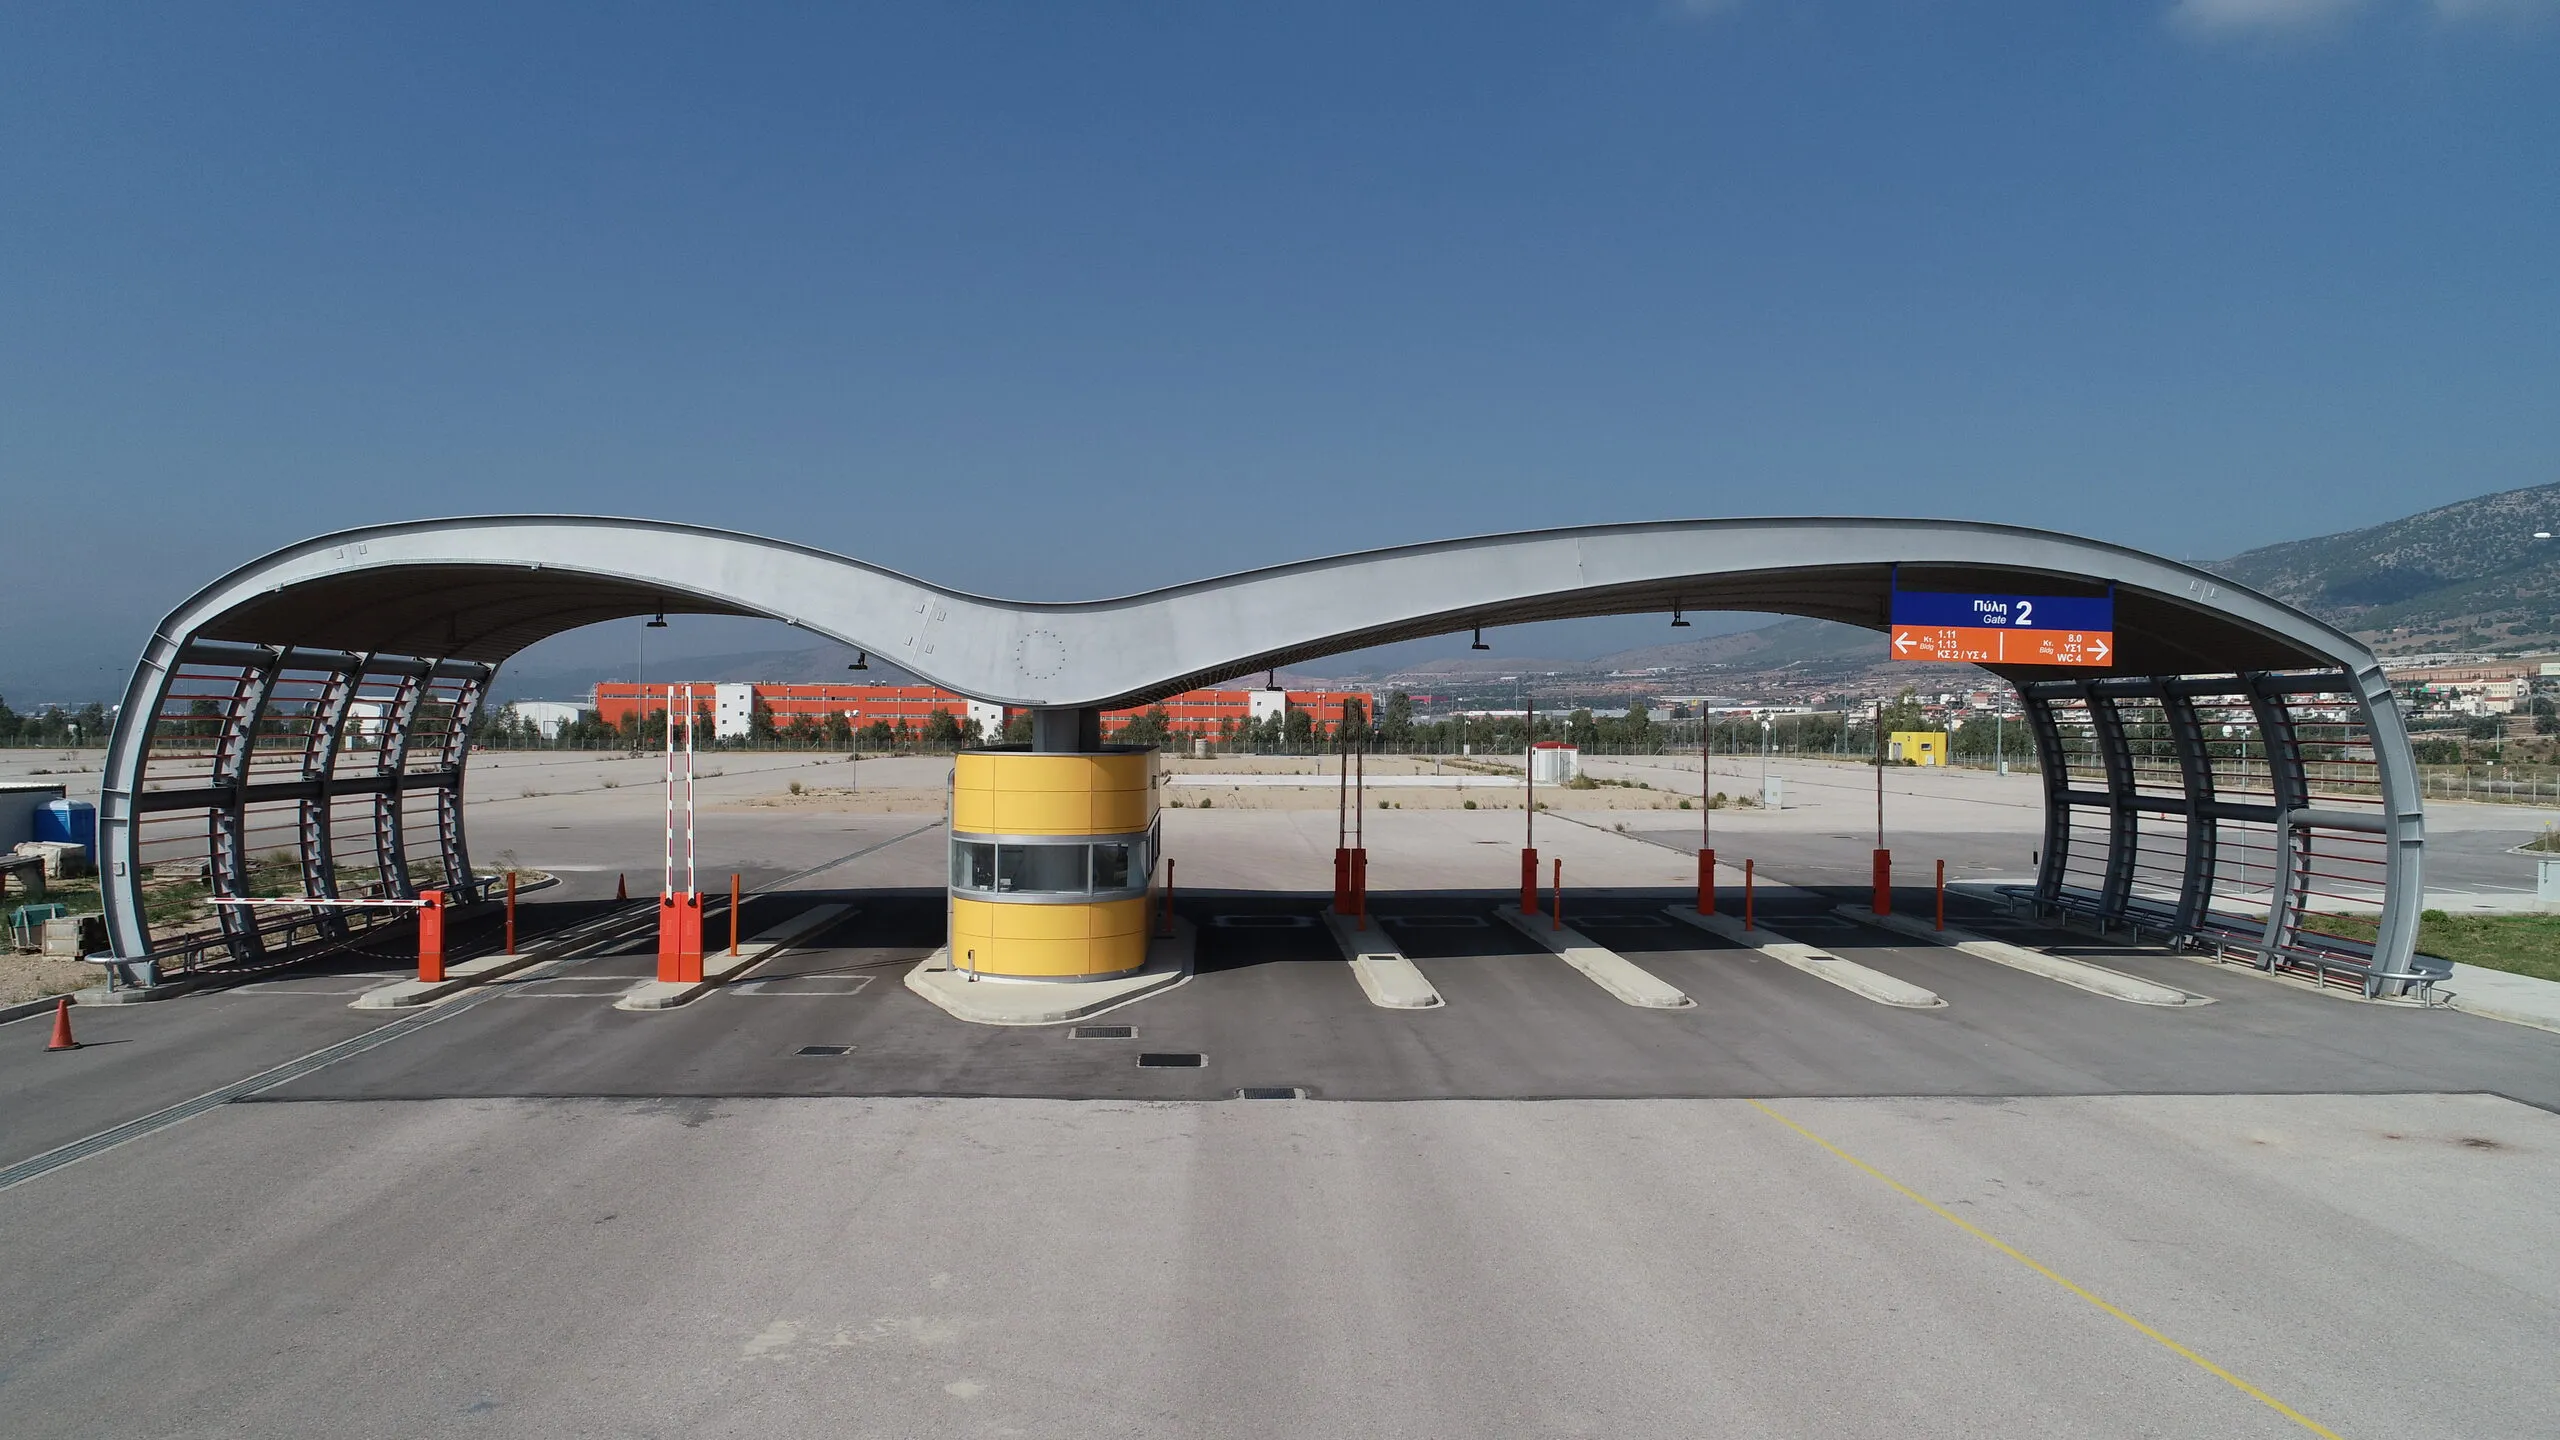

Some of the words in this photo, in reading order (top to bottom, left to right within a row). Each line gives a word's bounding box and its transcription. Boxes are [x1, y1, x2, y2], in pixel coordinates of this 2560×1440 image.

[1974, 600, 2007, 615] Πύλη
[2015, 601, 2032, 625] 2
[1984, 615, 2006, 624] Gate
[1938, 630, 1956, 638] 1.11
[2068, 634, 2082, 642] 8.0
[1938, 640, 1957, 648] 1.13
[1981, 652, 1987, 660] 4
[2057, 654, 2073, 662] WC
[2075, 654, 2082, 662] 4
